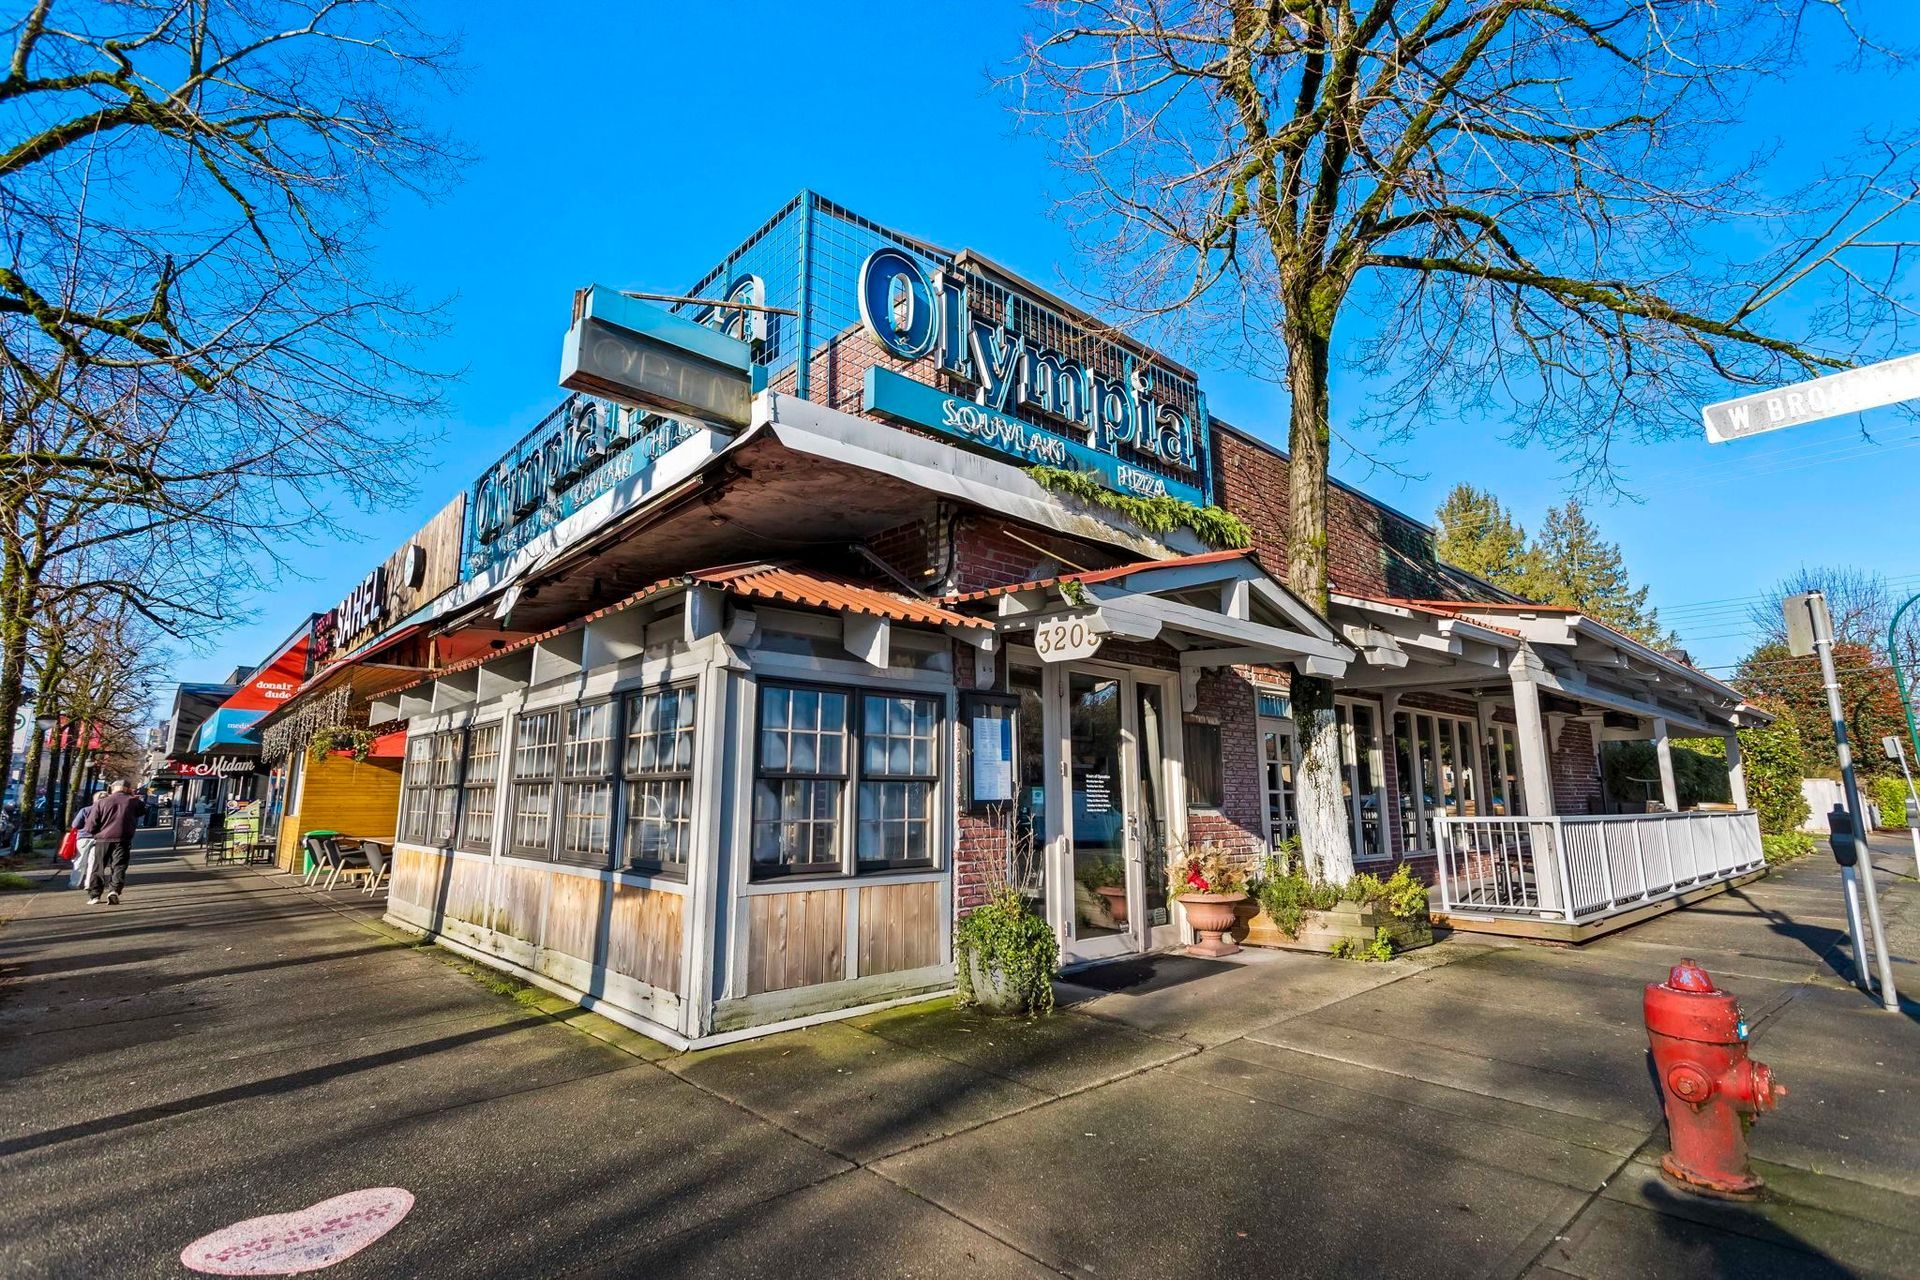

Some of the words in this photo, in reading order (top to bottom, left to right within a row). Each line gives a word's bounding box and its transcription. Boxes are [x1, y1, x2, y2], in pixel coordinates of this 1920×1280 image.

[859, 247, 1197, 472] Olympia
[1728, 404, 1750, 431] W
[942, 399, 1066, 464] SOUVLAKI
[1117, 465, 1167, 498] PIZZA
[335, 566, 380, 648] SAHEL
[256, 681, 294, 691] donair
[264, 690, 292, 699] dude
[195, 756, 256, 779] Midam
[204, 1233, 275, 1260] LOVE
